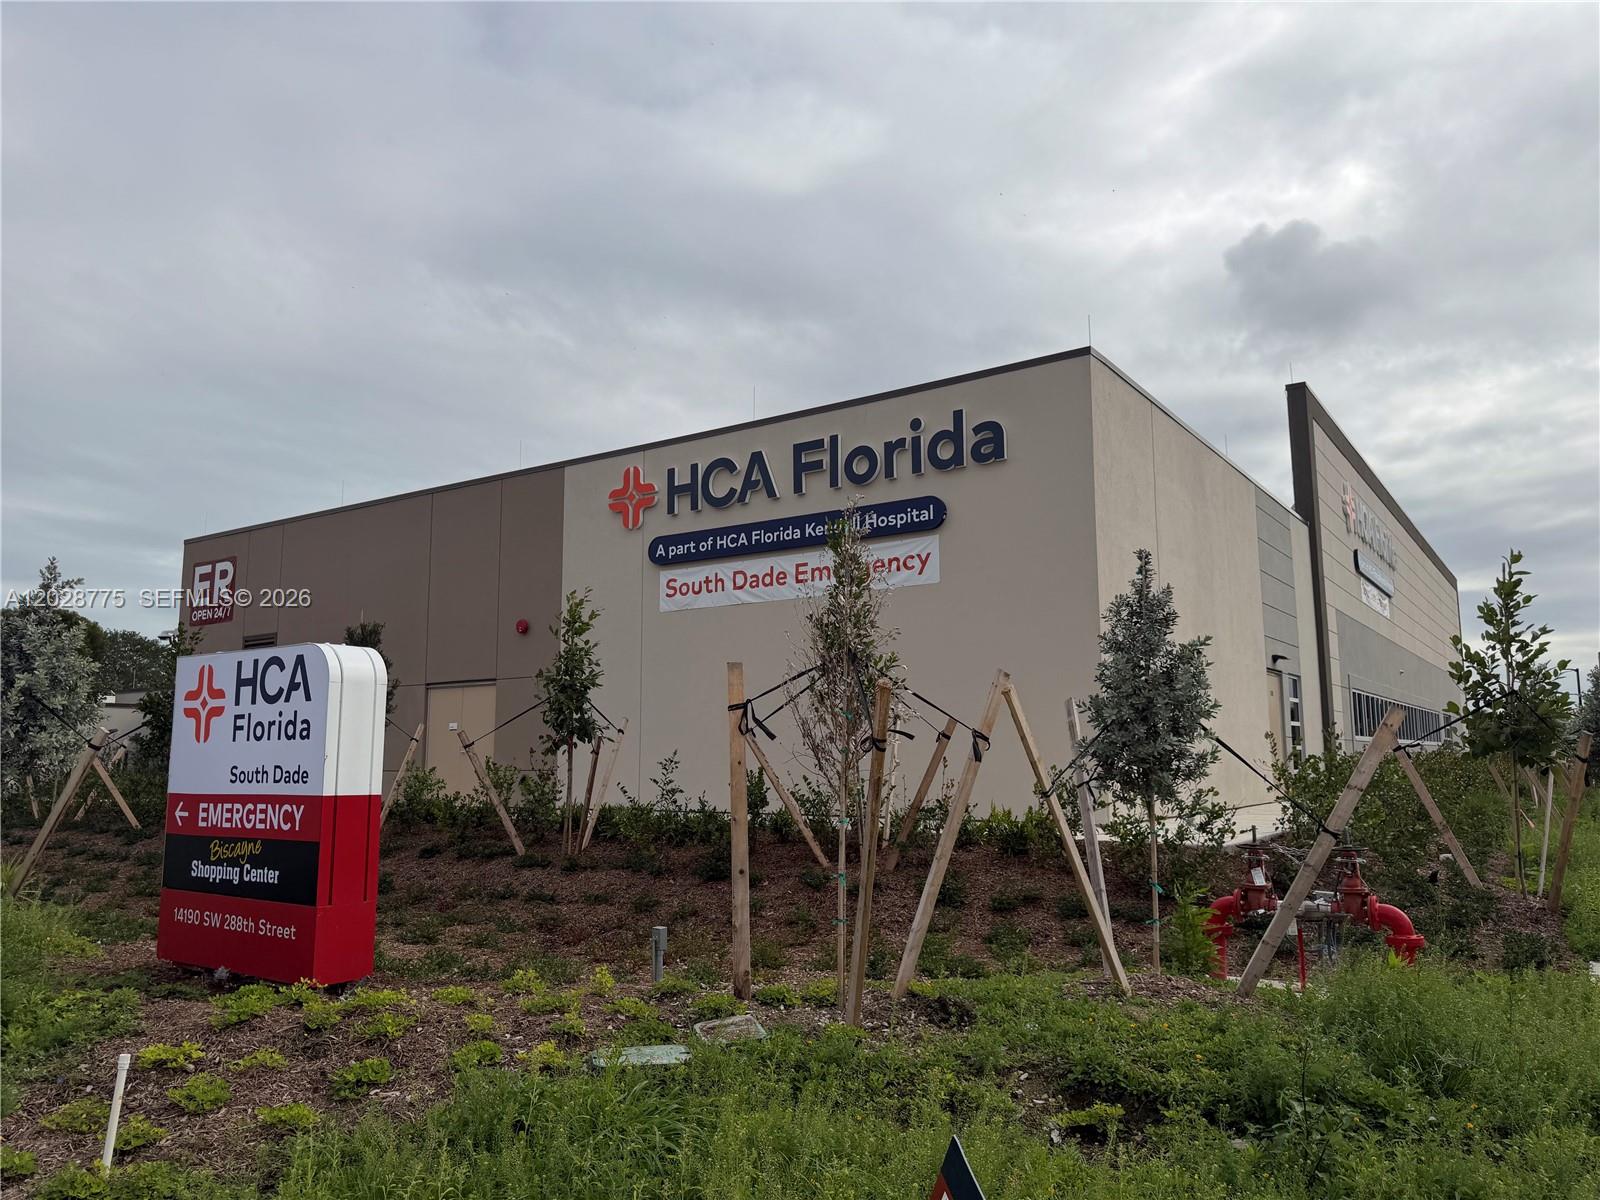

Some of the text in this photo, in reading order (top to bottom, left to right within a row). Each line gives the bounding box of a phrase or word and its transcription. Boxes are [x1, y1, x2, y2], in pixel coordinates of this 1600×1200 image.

[667, 409, 1007, 515] HCA Florida
[655, 504, 934, 559] A part of HCA Florida Kell Hospital
[193, 560, 234, 605] ER
[665, 551, 931, 598] South Dade Emency
[191, 606, 231, 622] OPEN 24/7
[234, 654, 312, 707] HCA
[232, 710, 311, 743] Florida
[229, 764, 309, 784] South Dade
[198, 803, 304, 831] EMERGENCY
[209, 838, 262, 864] Biscayne
[191, 860, 280, 885] Shopping Center
[173, 907, 296, 940] 14190 SW 288th Street
